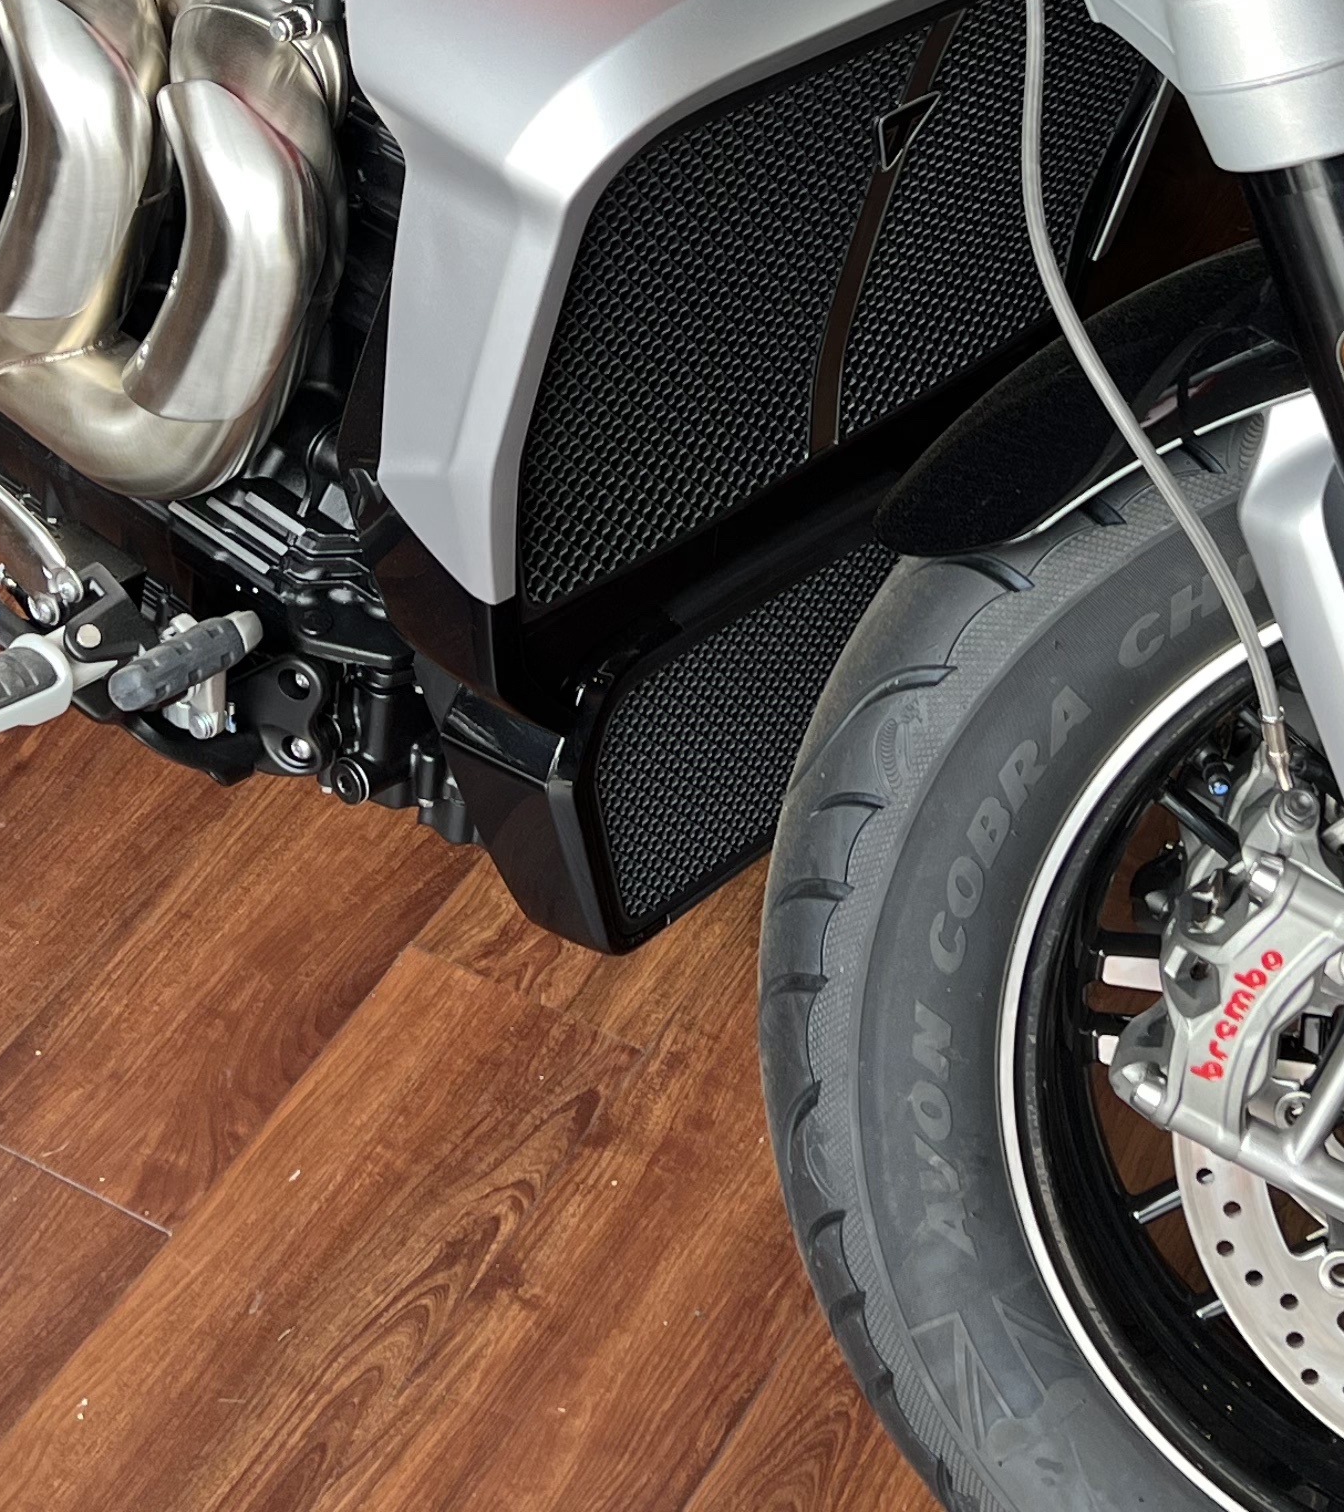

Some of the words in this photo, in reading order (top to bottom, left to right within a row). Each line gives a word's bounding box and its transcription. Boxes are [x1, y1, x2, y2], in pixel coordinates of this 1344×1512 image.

[929, 684, 1093, 976] COBRA
[908, 1000, 979, 1261] AVON
[1190, 949, 1284, 1082] brembo
